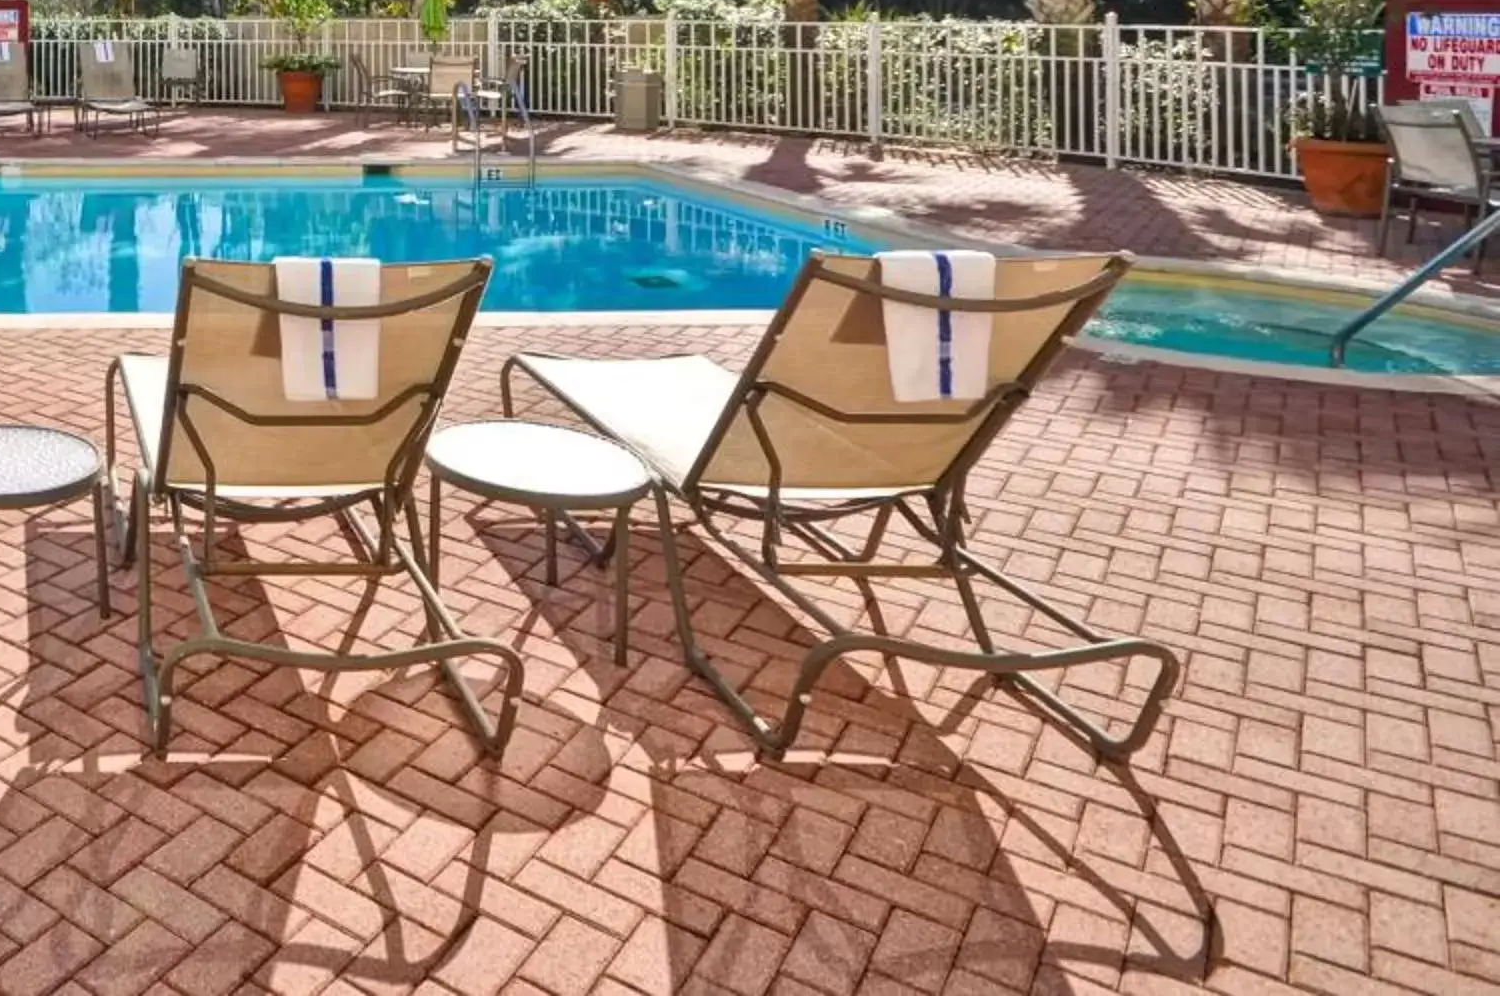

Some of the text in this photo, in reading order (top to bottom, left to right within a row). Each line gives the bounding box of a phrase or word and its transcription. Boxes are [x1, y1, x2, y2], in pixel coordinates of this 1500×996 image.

[1418, 15, 1500, 37] WARNING
[1412, 37, 1428, 52] NO
[1428, 54, 1485, 72] ON DUTY
